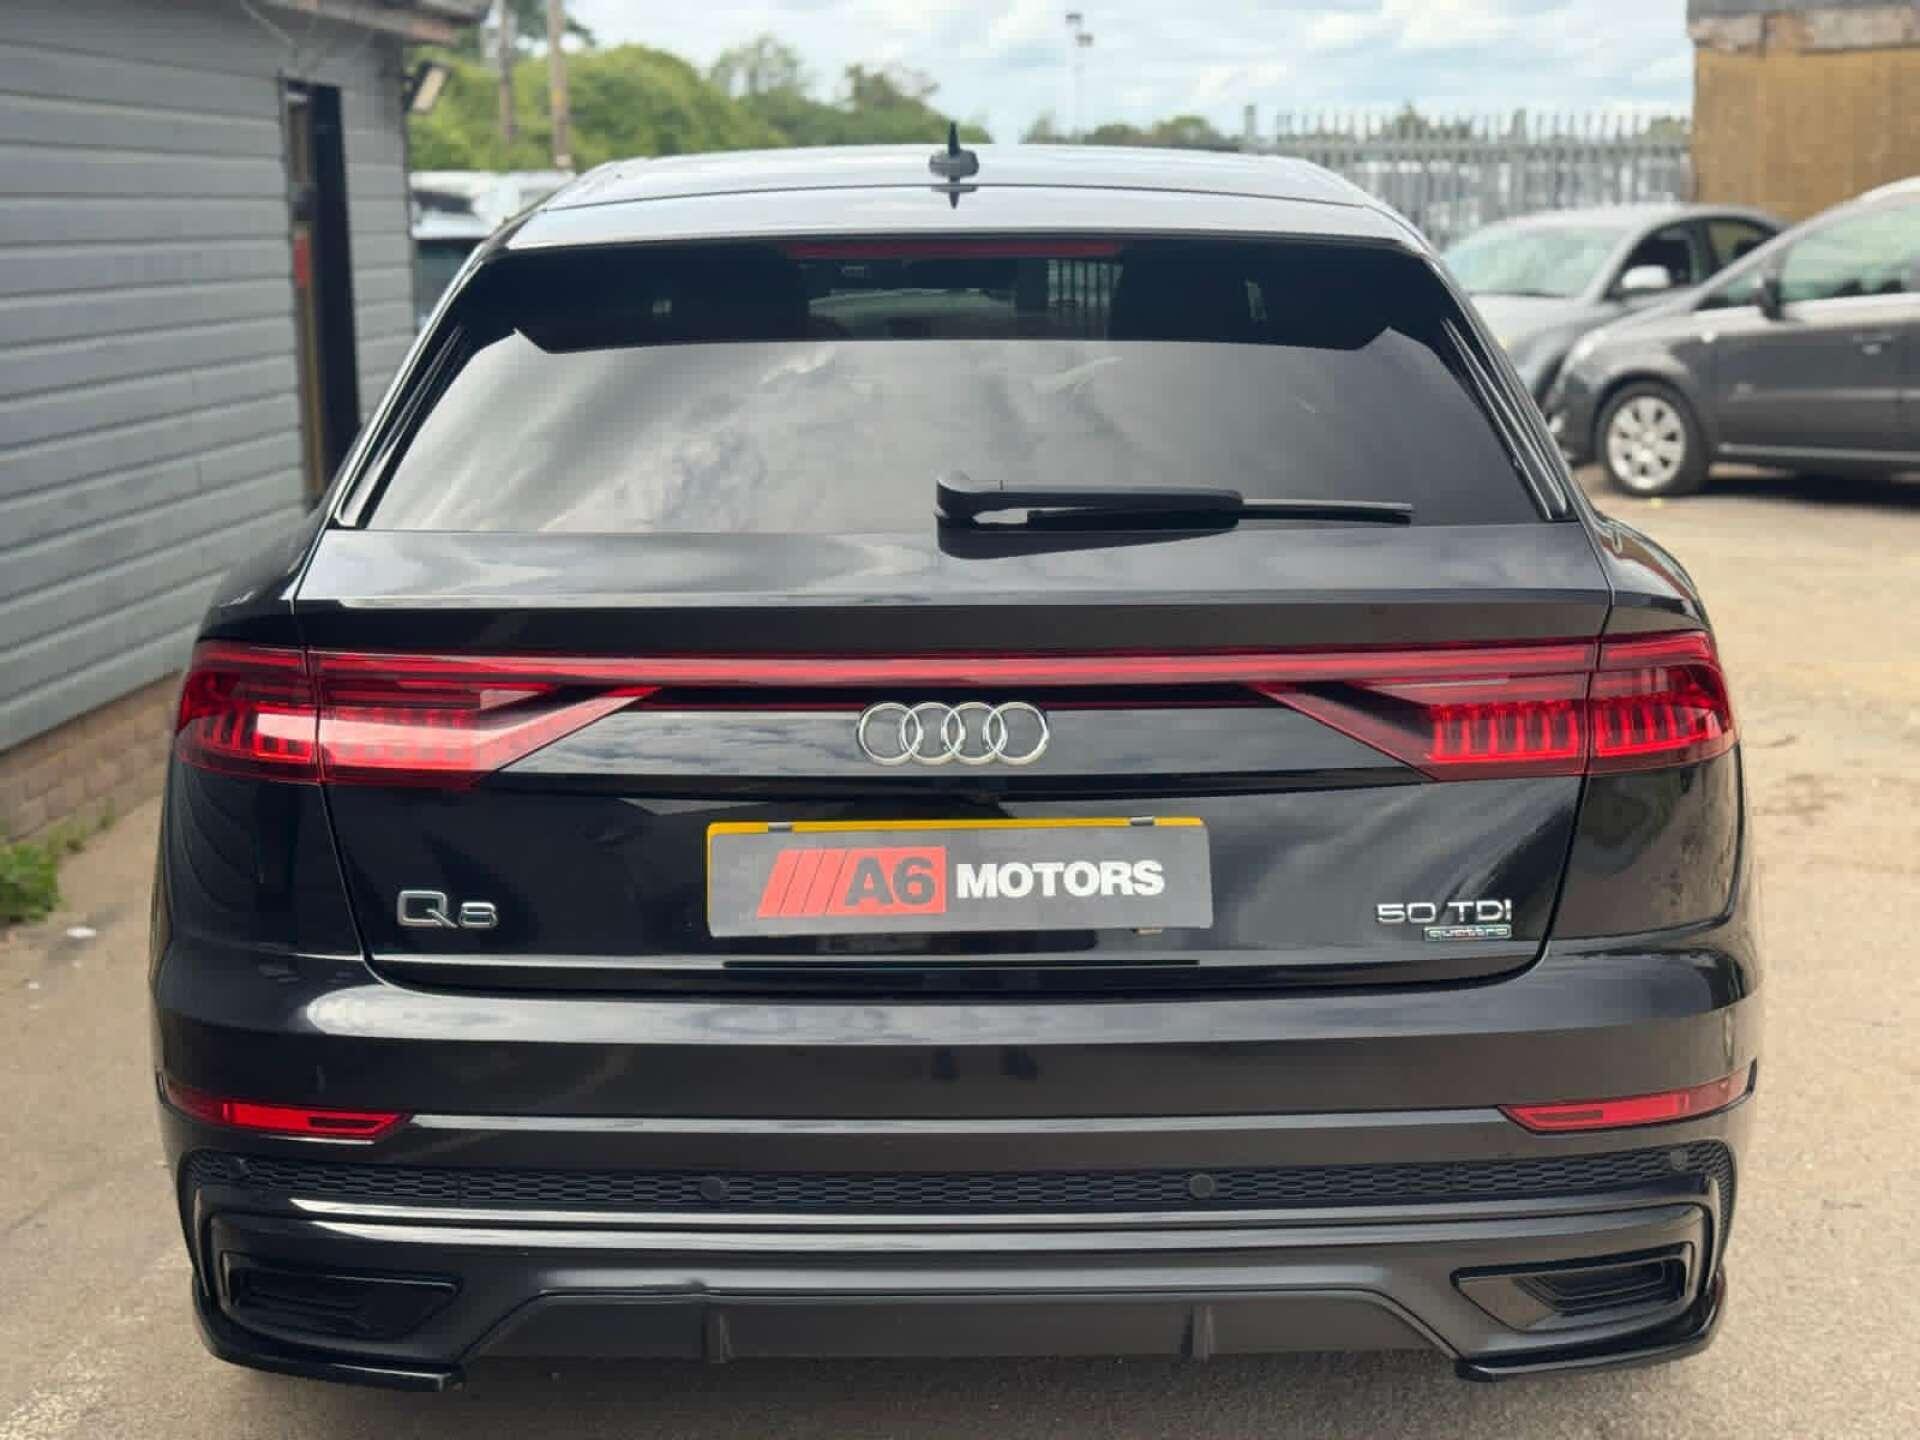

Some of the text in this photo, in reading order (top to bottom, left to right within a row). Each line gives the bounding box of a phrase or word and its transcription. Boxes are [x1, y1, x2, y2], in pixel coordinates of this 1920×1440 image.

[844, 856, 1165, 906] A6 MOTORS
[397, 890, 498, 928] Q8
[1377, 899, 1512, 923] 50 TDI
